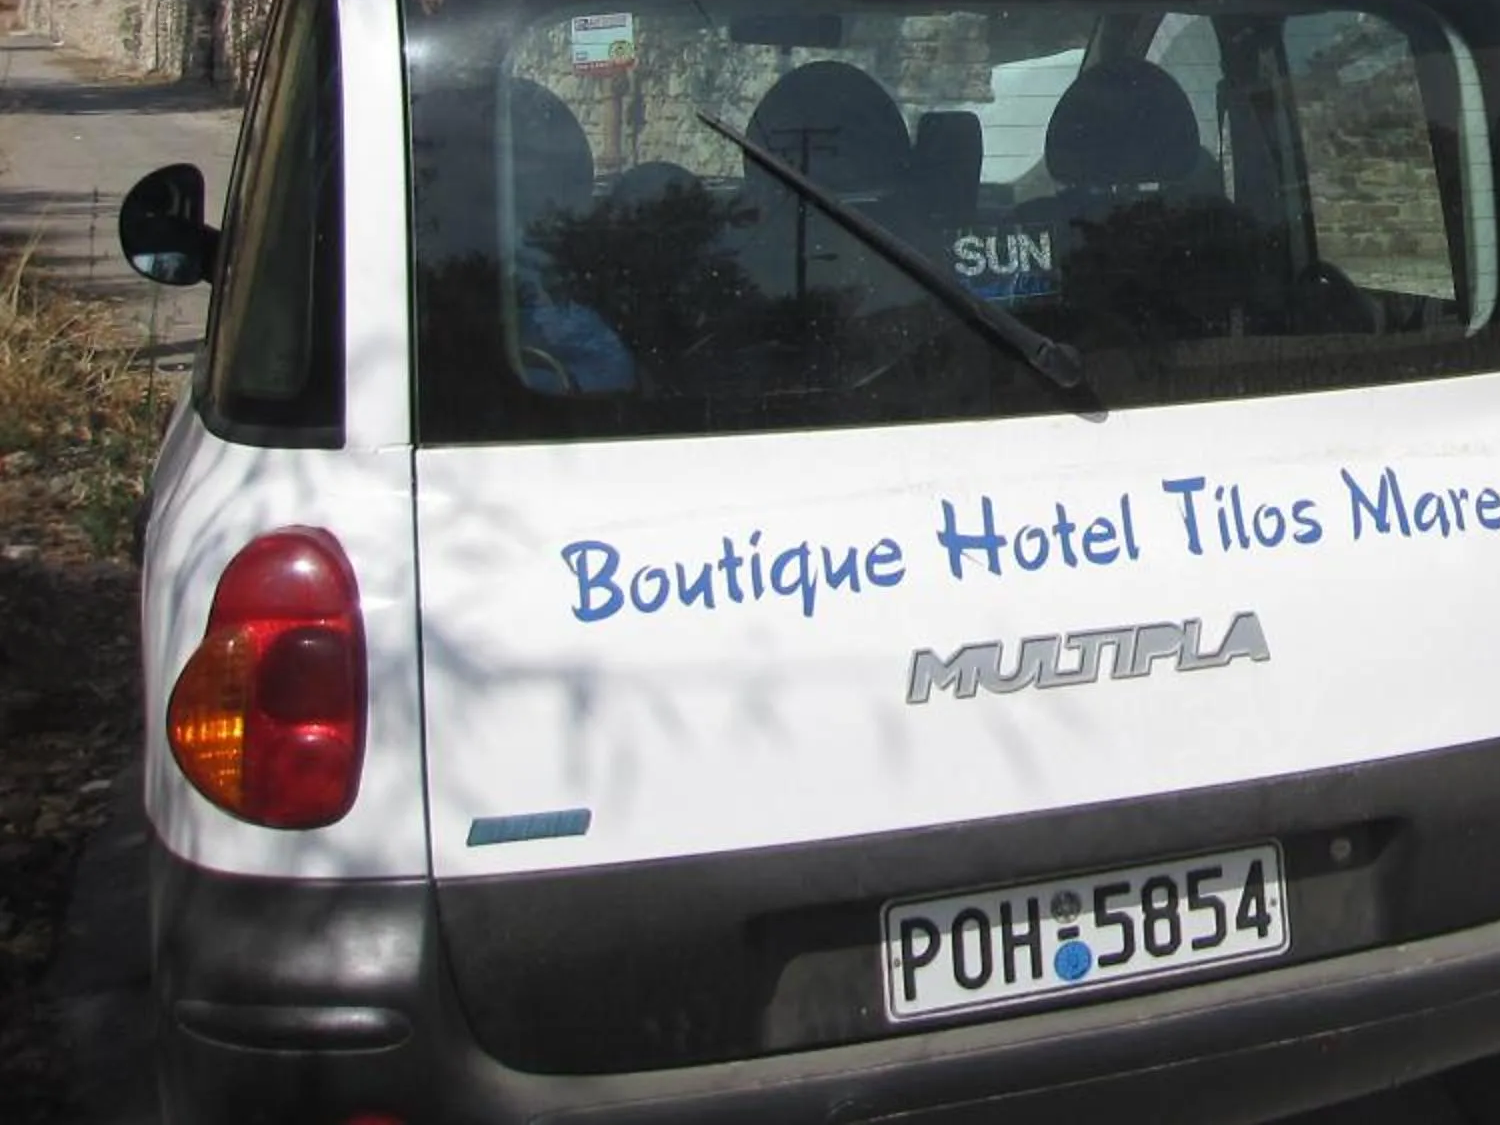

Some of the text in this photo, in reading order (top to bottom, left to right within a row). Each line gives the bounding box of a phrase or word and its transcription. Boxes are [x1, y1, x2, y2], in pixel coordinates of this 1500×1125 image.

[953, 232, 1052, 276] SUN
[560, 530, 905, 623] Boutique
[937, 493, 1142, 581] Hotel
[1161, 476, 1323, 556] Tilos
[905, 611, 1271, 705] MULTIPLA
